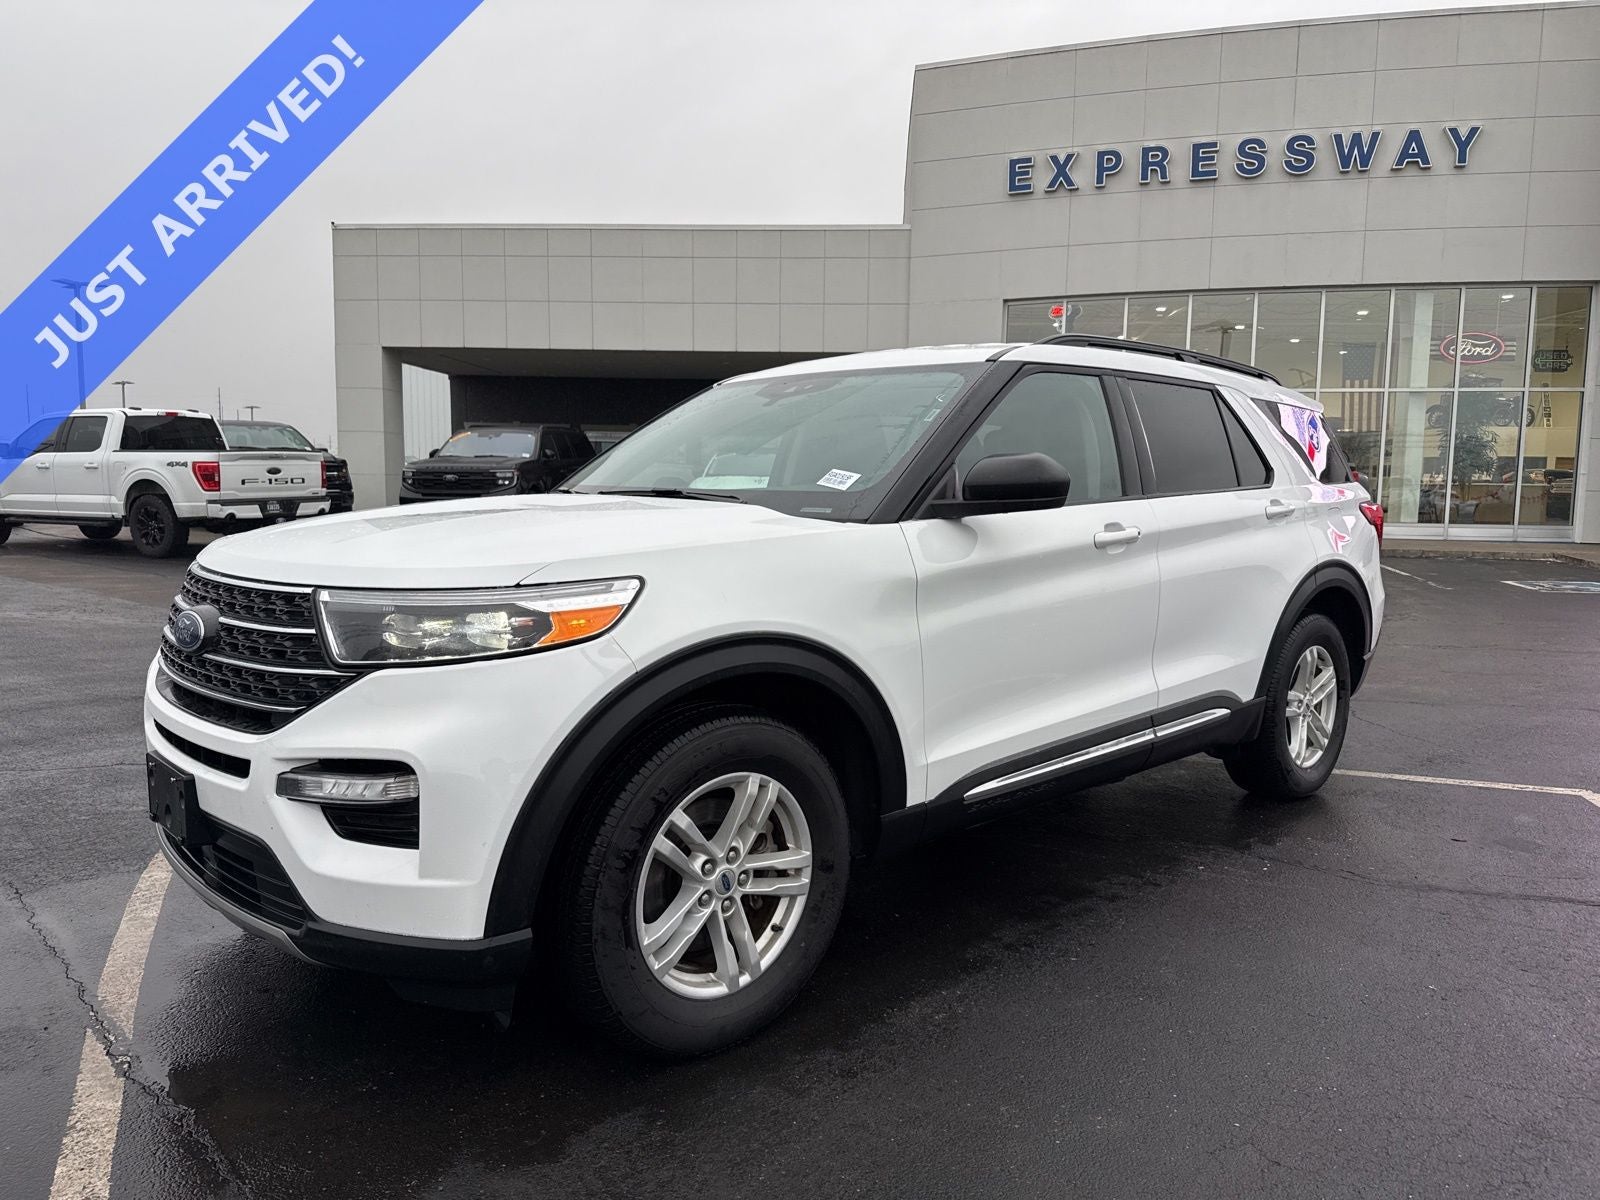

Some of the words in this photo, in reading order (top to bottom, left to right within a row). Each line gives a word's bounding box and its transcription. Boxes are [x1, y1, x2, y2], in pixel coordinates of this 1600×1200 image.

[1007, 126, 1482, 195] EXPRESSWAY
[1448, 339, 1498, 356] Ford
[1540, 351, 1568, 360] USED
[1539, 361, 1567, 369] CARS
[241, 477, 306, 486] F-150
